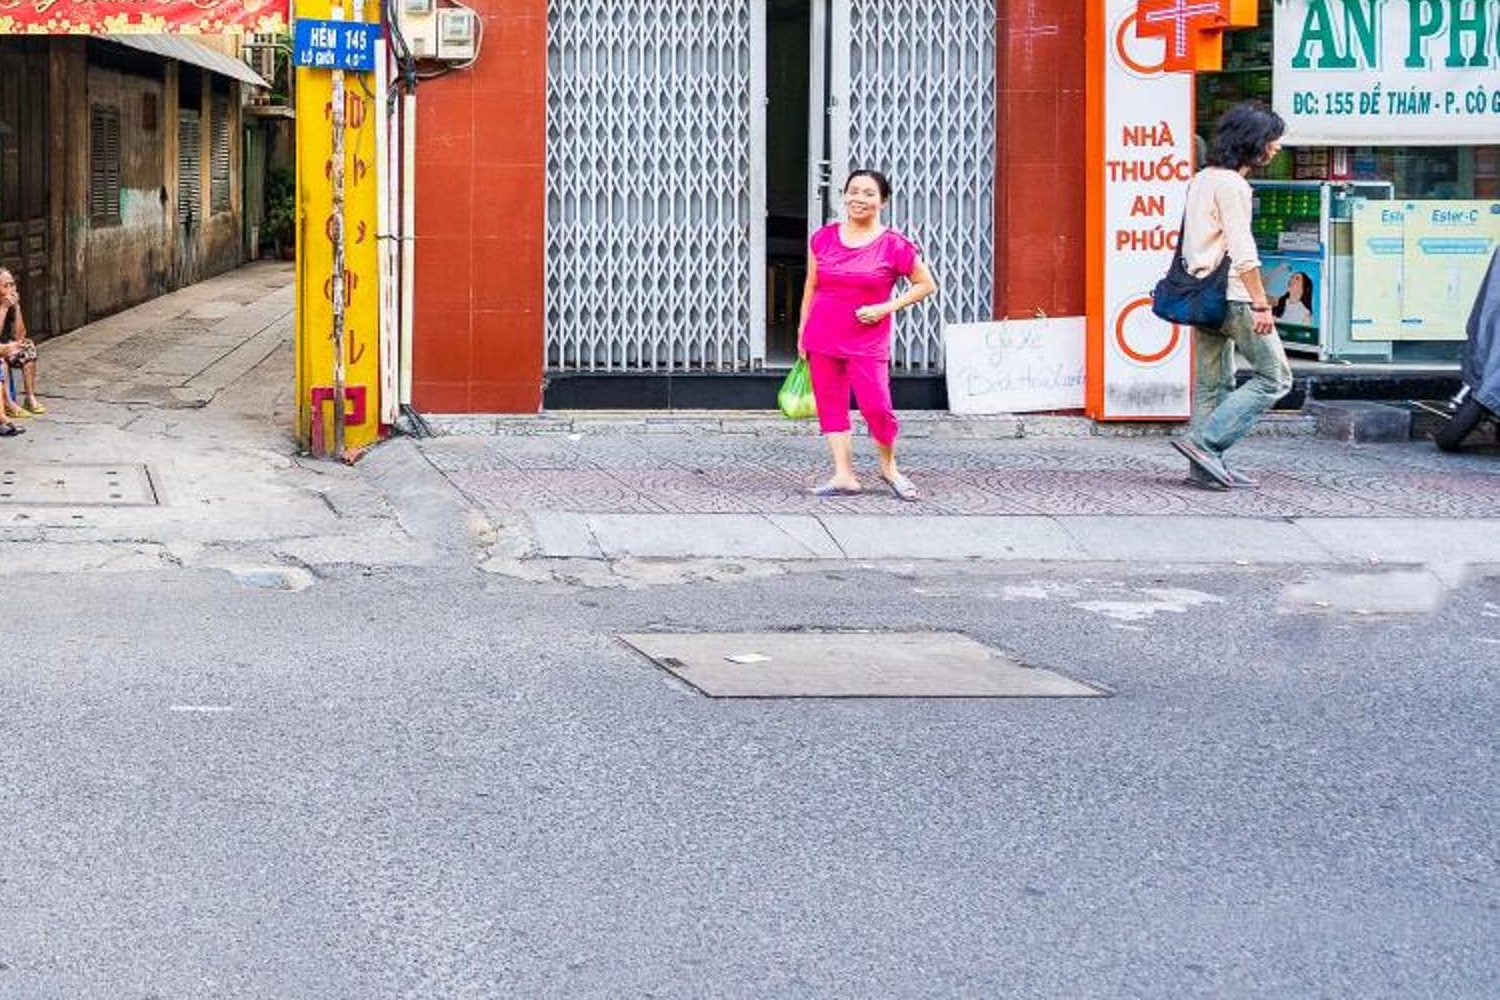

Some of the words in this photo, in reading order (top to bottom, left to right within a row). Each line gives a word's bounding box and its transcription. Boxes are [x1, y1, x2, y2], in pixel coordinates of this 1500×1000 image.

[345, 29, 367, 51] 145
[1325, 92, 1354, 115] 155
[1387, 86, 1432, 115] THÁM
[1465, 85, 1487, 115] CÔ
[1122, 120, 1175, 147] NHÀ
[1107, 153, 1190, 182] THUỐC
[1130, 196, 1165, 217] AN
[1116, 225, 1182, 251] PHÚC
